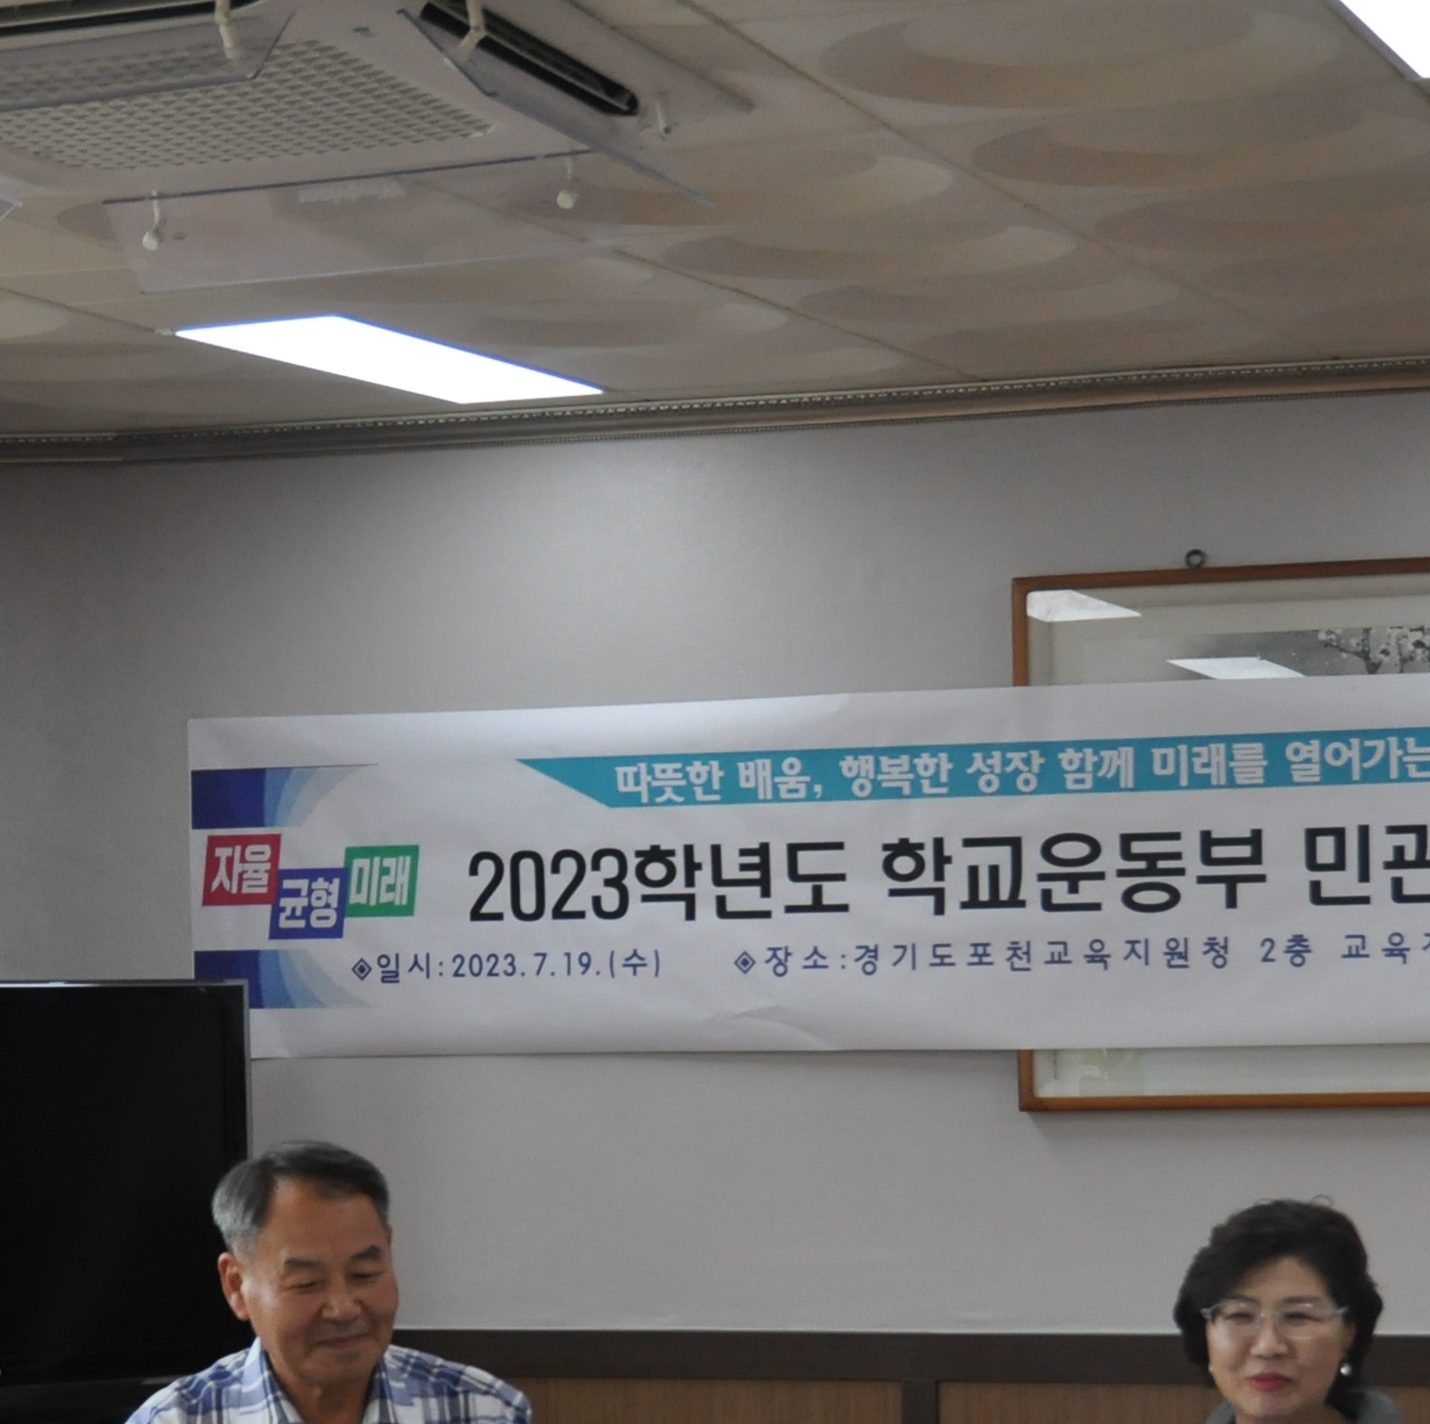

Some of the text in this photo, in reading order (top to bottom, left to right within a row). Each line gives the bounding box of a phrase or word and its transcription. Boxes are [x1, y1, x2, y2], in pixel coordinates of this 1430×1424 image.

[614, 760, 725, 803] 따뜻한
[738, 757, 823, 801] 배움,
[839, 753, 954, 798] 행복한
[966, 749, 1045, 796] 성장
[1057, 746, 1135, 792] 함께
[1152, 741, 1268, 788] 미래를
[211, 844, 411, 929] 자율 균형 미래
[468, 840, 850, 922] 2023학년도
[881, 828, 1268, 916] 학교운동부
[1261, 934, 1312, 968] 2층
